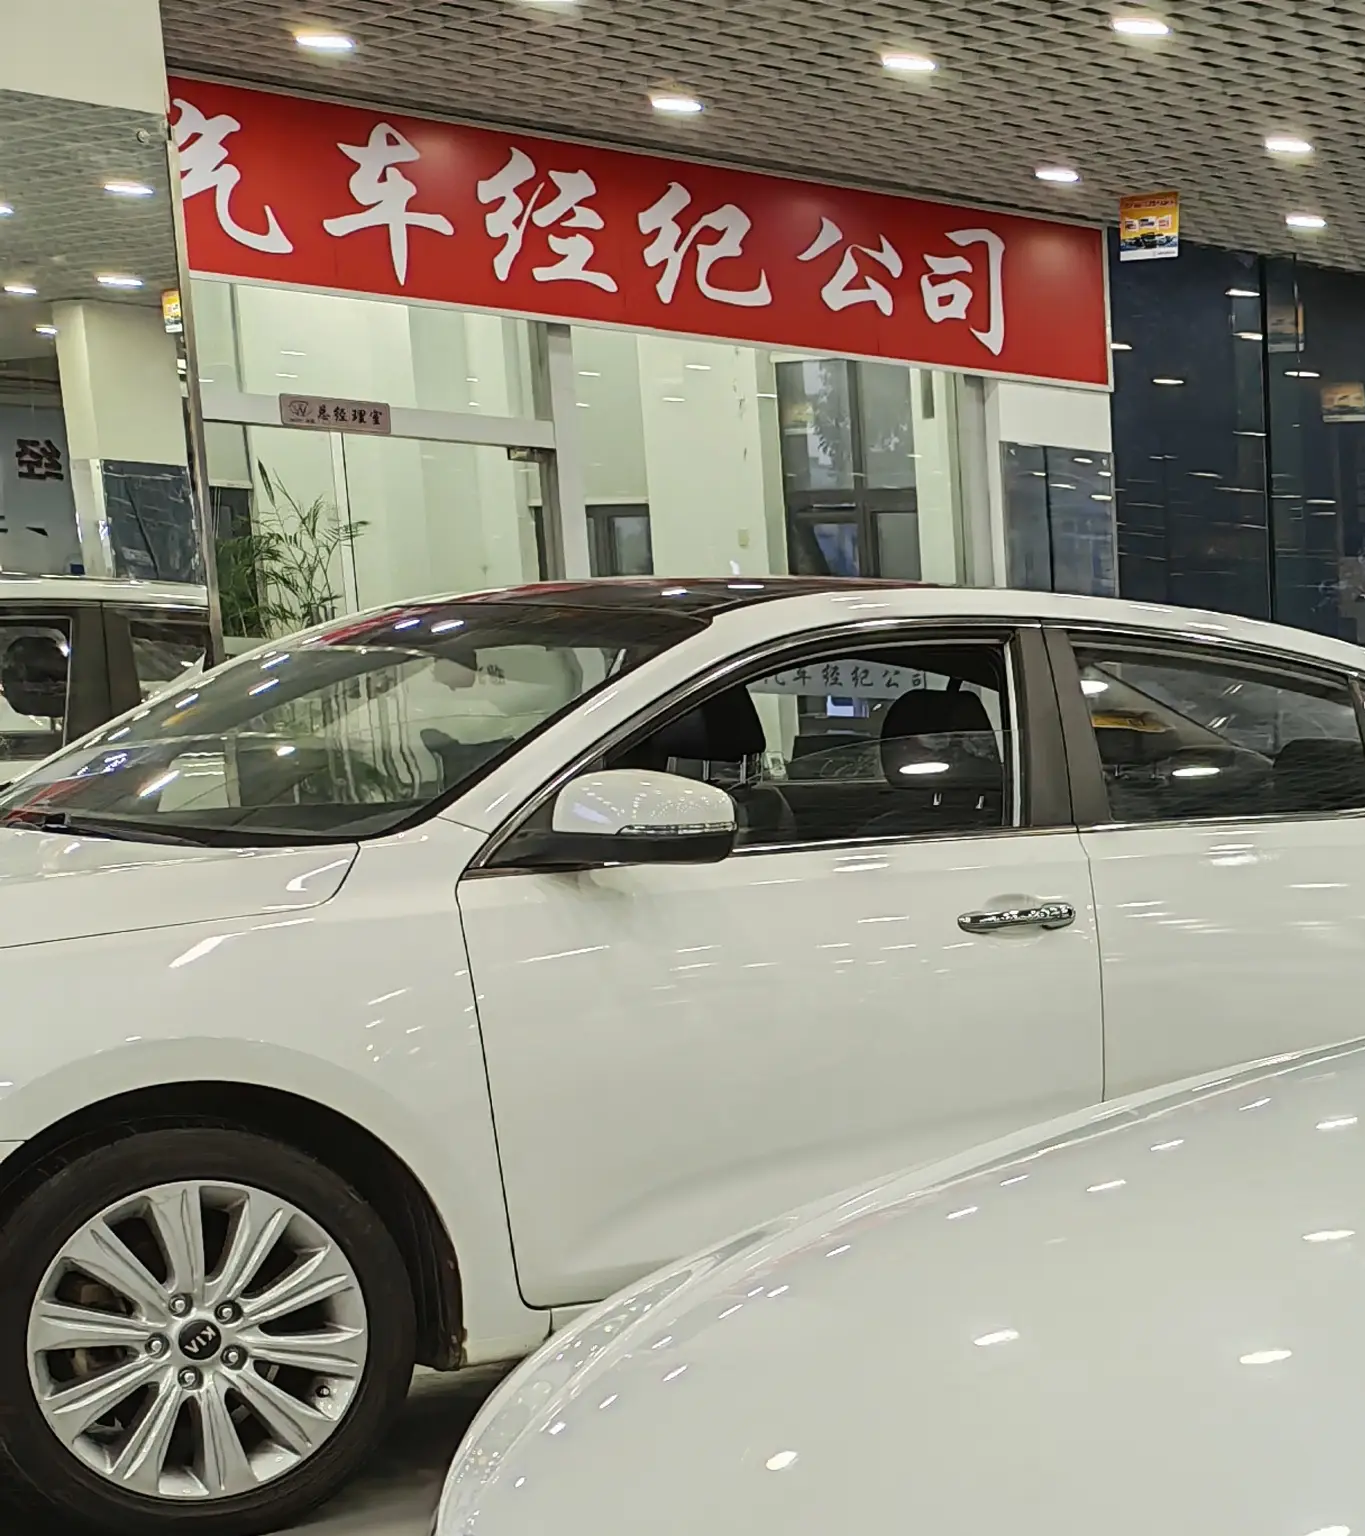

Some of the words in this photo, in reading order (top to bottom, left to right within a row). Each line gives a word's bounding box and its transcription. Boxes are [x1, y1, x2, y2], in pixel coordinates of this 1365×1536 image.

[172, 98, 1006, 356] 汽车经纪公司
[317, 404, 383, 425] 总经理室
[184, 1325, 216, 1353] KIA
